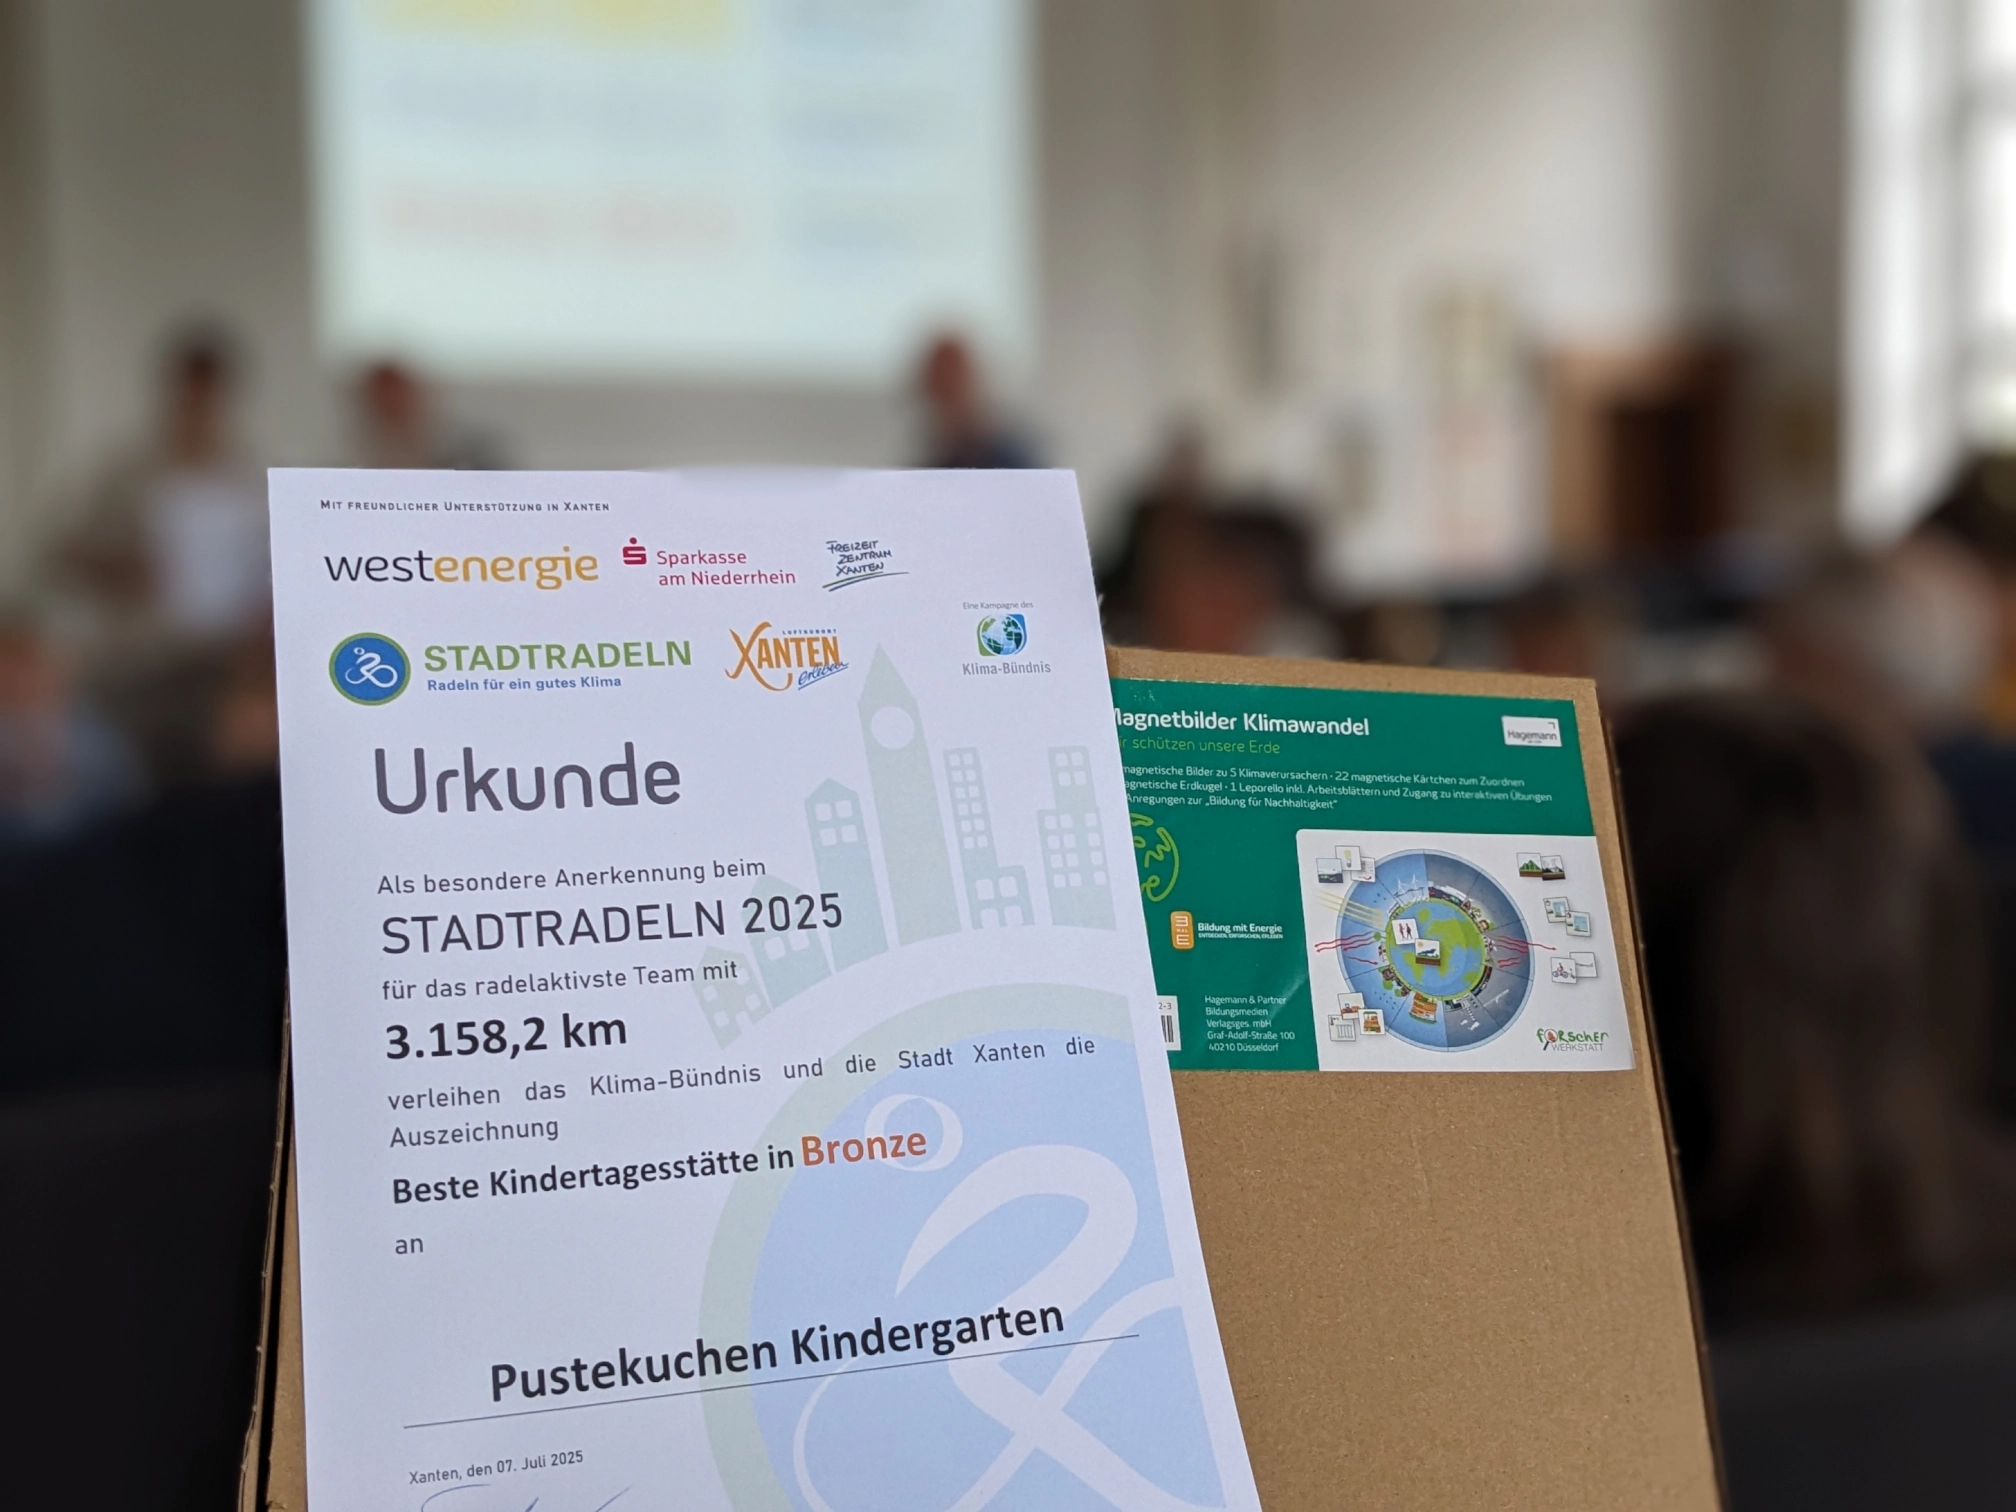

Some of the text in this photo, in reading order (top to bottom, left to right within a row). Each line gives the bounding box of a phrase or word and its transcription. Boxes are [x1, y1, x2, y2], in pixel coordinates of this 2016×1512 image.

[324, 546, 599, 590] westenergie
[656, 550, 747, 568] Sparkasse
[658, 569, 796, 586] am Niederrhein
[835, 561, 885, 577] XANTEN
[962, 601, 1034, 611] Eine Kampagne des
[424, 639, 692, 673] STADTRADELN
[724, 621, 840, 692] XANTEN
[962, 661, 1052, 676] Klima-Bündnis
[427, 675, 622, 692] Radeln für ein gutes Klima
[1243, 713, 1370, 736] Klimawandel
[1507, 729, 1558, 741] Hagemann
[1132, 736, 1195, 751] schützen
[1199, 741, 1245, 753] unsere
[1249, 740, 1281, 754] Erde
[374, 741, 681, 815] Urkunde
[1186, 766, 1214, 777] Bilder
[1216, 768, 1228, 778] zu
[1238, 767, 1328, 781] Klimaverursachern
[1335, 771, 1349, 781] 22
[1351, 772, 1412, 784] magnetische
[1413, 773, 1457, 785] Kärtchen
[1458, 777, 1478, 786] zum
[1480, 775, 1525, 787] Zuordnen
[1124, 779, 1553, 803] agnetische Erdkugel 1 Leporello inkl. Arbeitsblättern und Zugang zu interaktiven Übungen
[1187, 796, 1202, 805] zur
[1248, 797, 1263, 807] für
[377, 858, 767, 895] Als besondere Anerkennung beim
[382, 892, 843, 955] STADTRADELN 2025
[1197, 922, 1283, 935] Bildung mit Energie
[382, 960, 738, 1000] für das radelaktivste Team mit
[1204, 995, 1287, 1006] Hagemann & Partner
[1205, 1007, 1269, 1018] Bildungsmedien
[1206, 1019, 1272, 1029] Verlagsges. mbH
[385, 1013, 627, 1061] 3.158,2 km
[1207, 1031, 1296, 1041] Graf-Adolf-Straße 100
[1208, 1042, 1279, 1052] 40210 Düsseldorf
[1551, 1043, 1605, 1052] WERKSTATT
[387, 1036, 1096, 1111] verleihen das Klima-Bündnis und die Stadt Xanten die
[390, 1117, 560, 1148] Auszeichnung
[392, 1131, 927, 1205] Beste Kindertagesstätte in Bronze
[394, 1236, 424, 1255] an
[490, 1304, 1065, 1402] Pustekuchen Kindergarten
[409, 1450, 584, 1485] Xanten, den 07. Juli 2025
